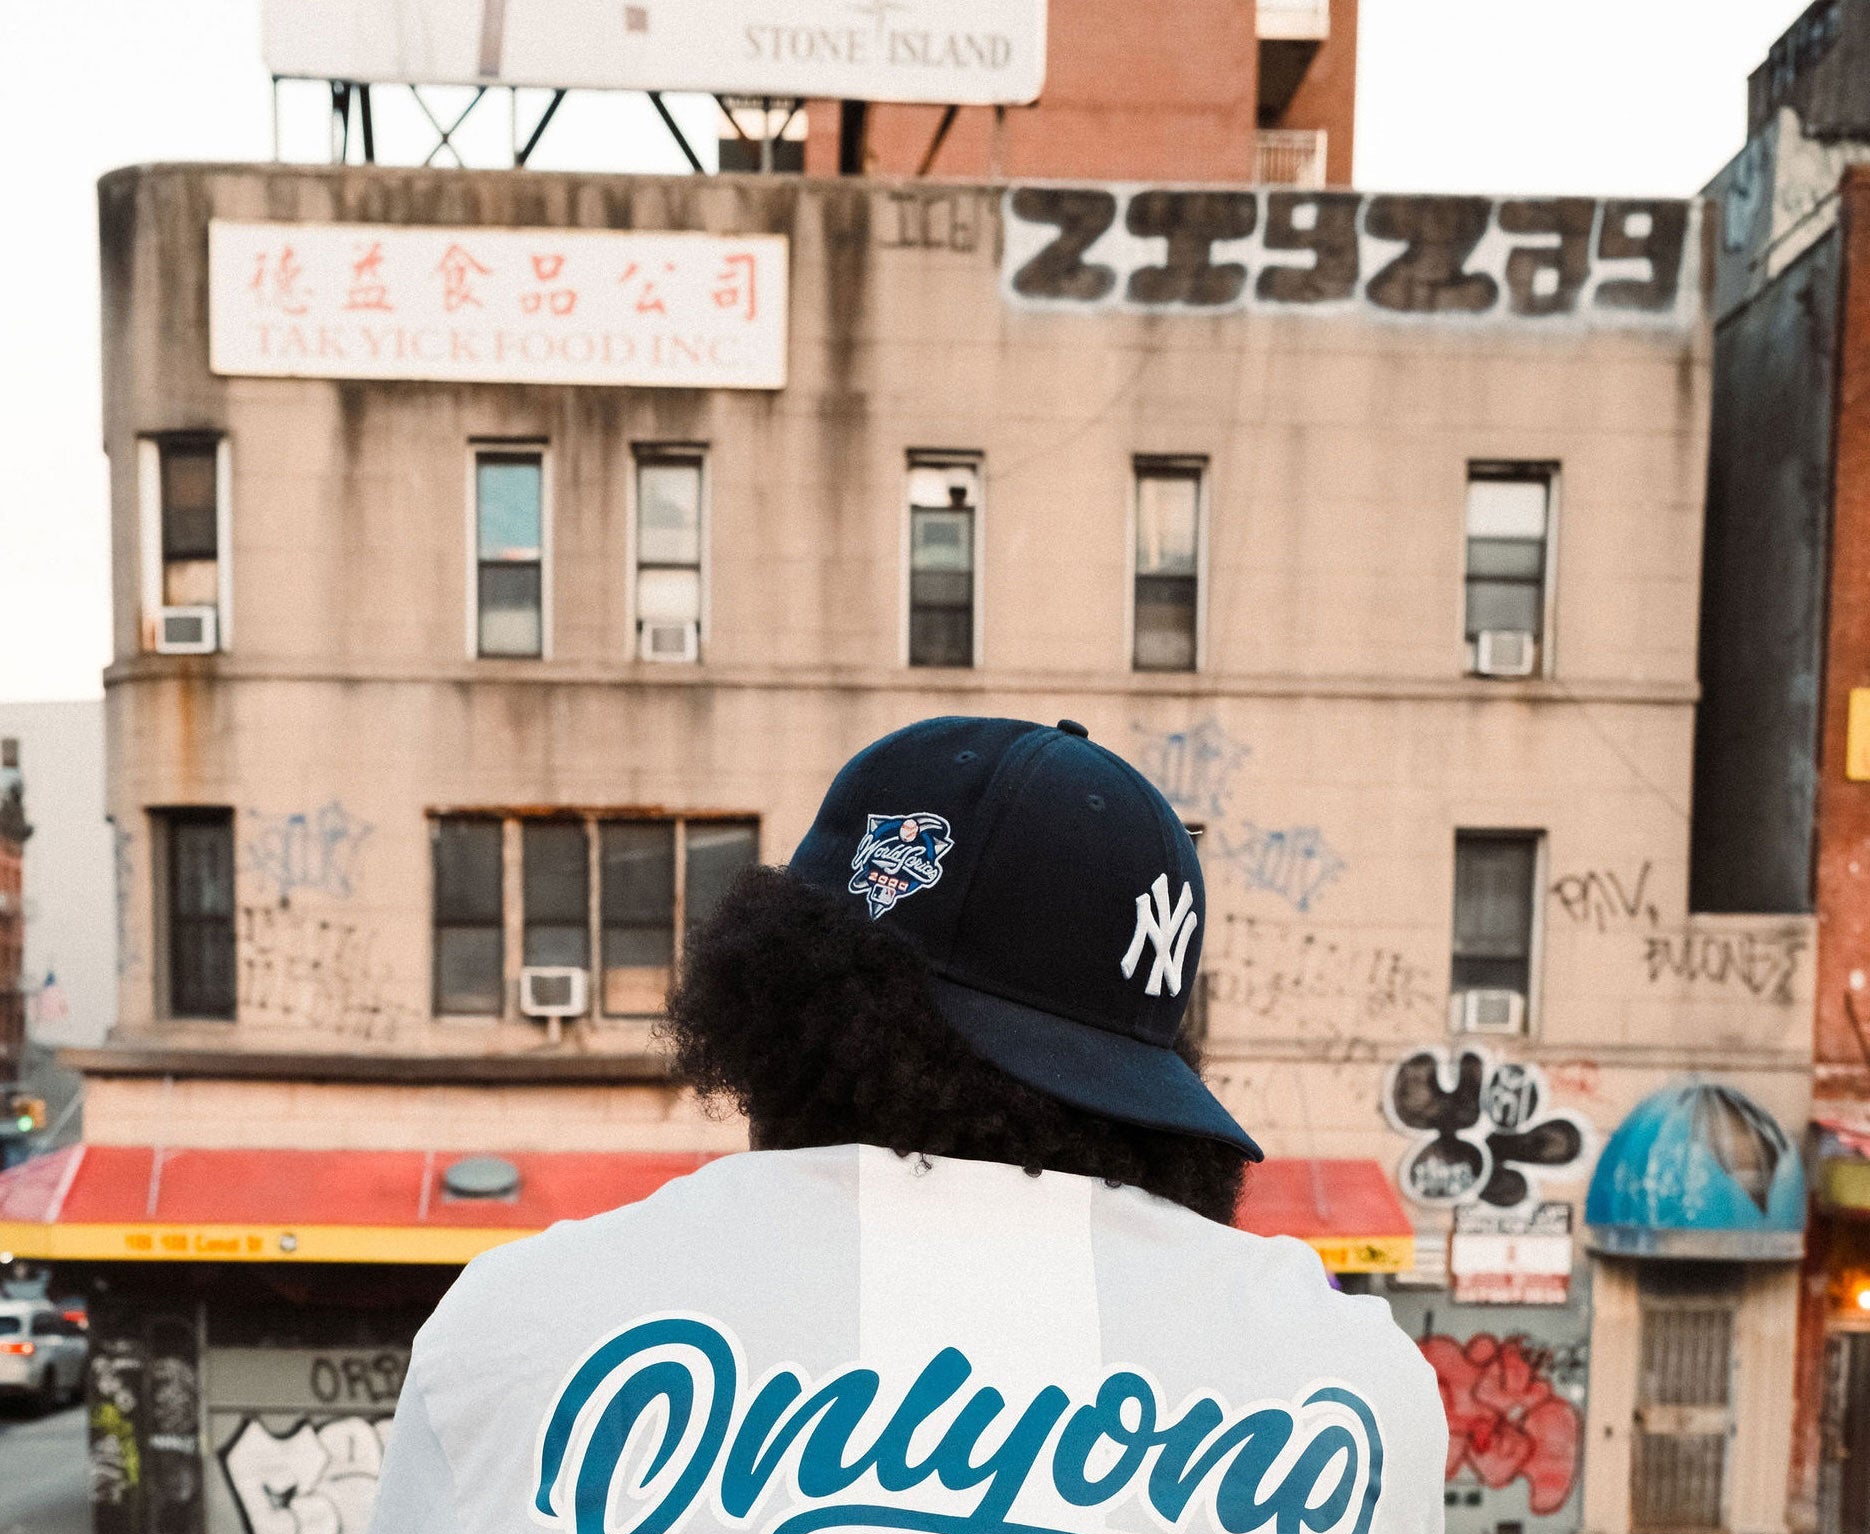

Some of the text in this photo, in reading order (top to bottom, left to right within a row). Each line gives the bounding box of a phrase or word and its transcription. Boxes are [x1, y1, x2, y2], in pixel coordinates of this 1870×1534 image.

[743, 24, 1013, 70] STONE ISLAND
[253, 324, 347, 358] TAK
[359, 326, 482, 362] YICK
[492, 328, 637, 366] FOOD
[852, 835, 938, 882] World Series
[868, 871, 908, 891] 2000
[1120, 872, 1198, 998] NY
